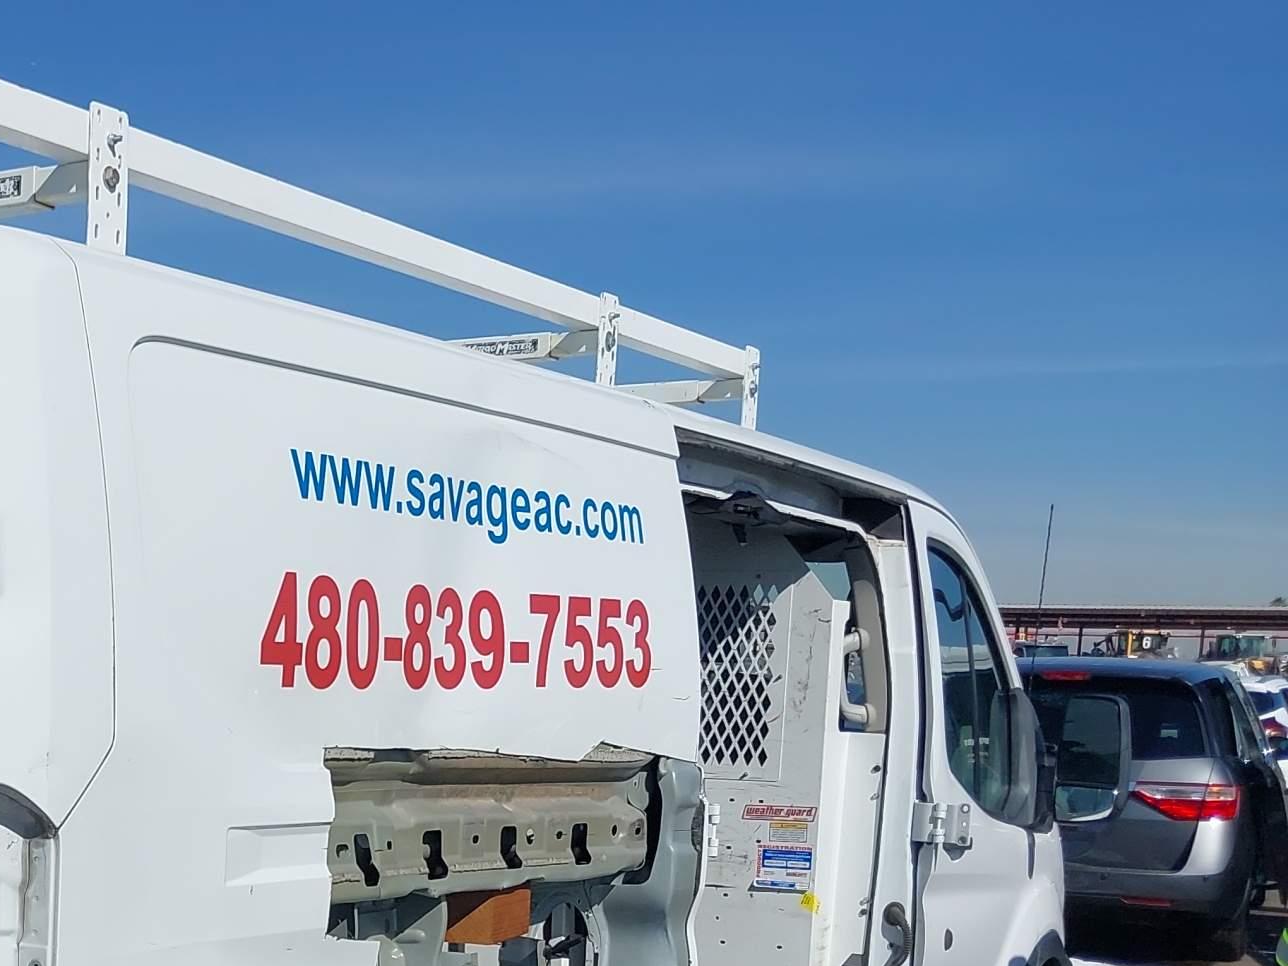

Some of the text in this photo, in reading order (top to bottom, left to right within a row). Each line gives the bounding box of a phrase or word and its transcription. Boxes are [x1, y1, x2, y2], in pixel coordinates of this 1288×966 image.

[290, 448, 645, 544] www.savageac.com
[259, 571, 652, 690] 480-839-7553
[1142, 636, 1152, 649] 6
